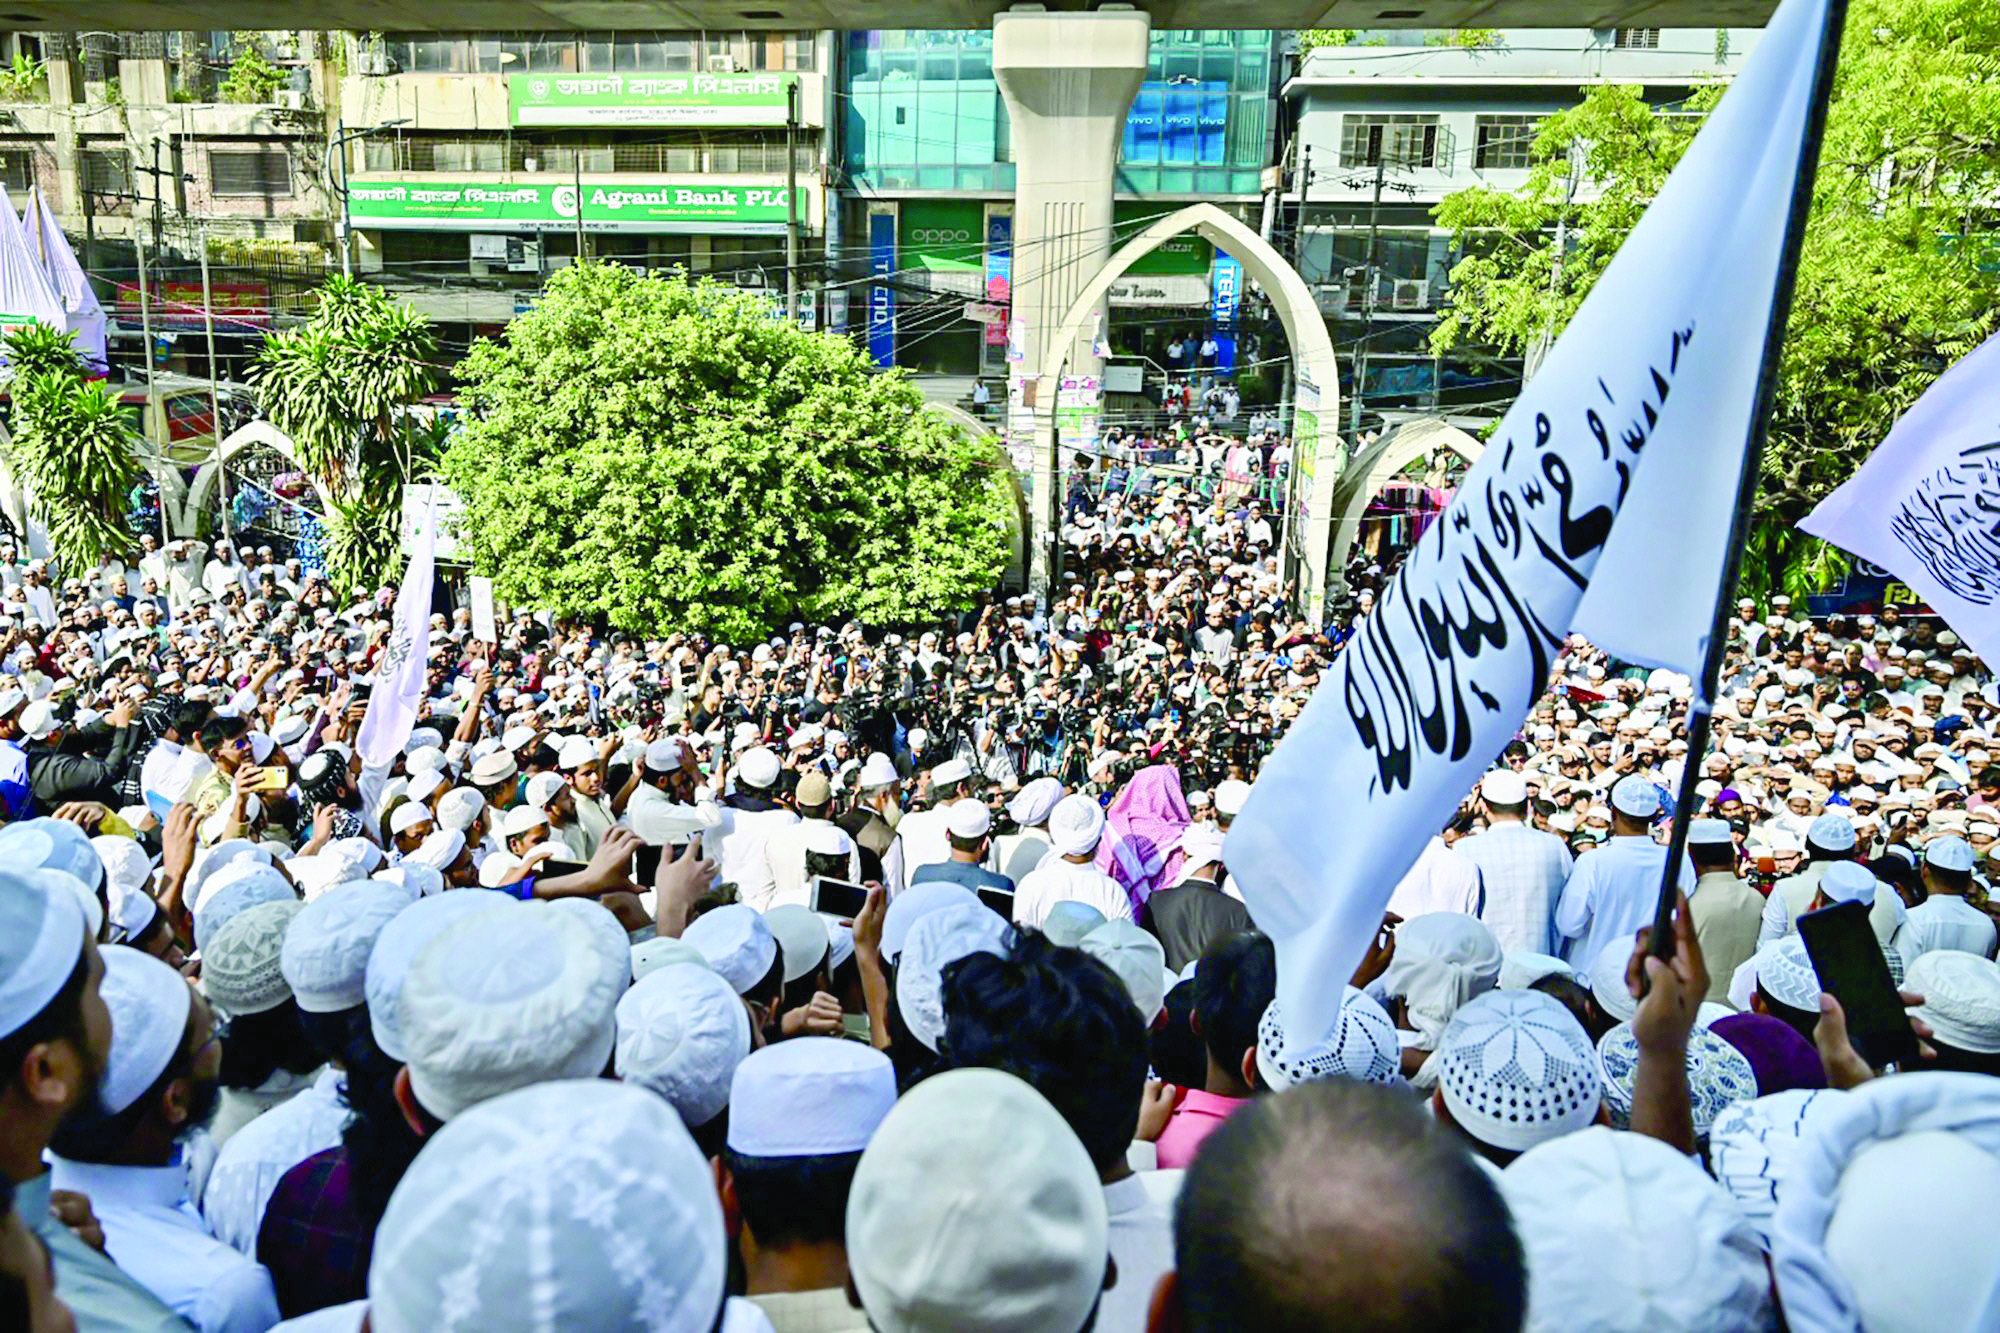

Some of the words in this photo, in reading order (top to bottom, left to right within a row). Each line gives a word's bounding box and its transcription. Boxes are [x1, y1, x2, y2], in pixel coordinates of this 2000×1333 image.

[628, 77, 688, 97] ব্যাংক
[1127, 117, 1153, 125] vivo
[1165, 115, 1191, 123] vivo
[1199, 116, 1226, 125] vivo
[590, 188, 668, 209] Agrani
[674, 188, 738, 206] Bank
[912, 229, 970, 244] oppo
